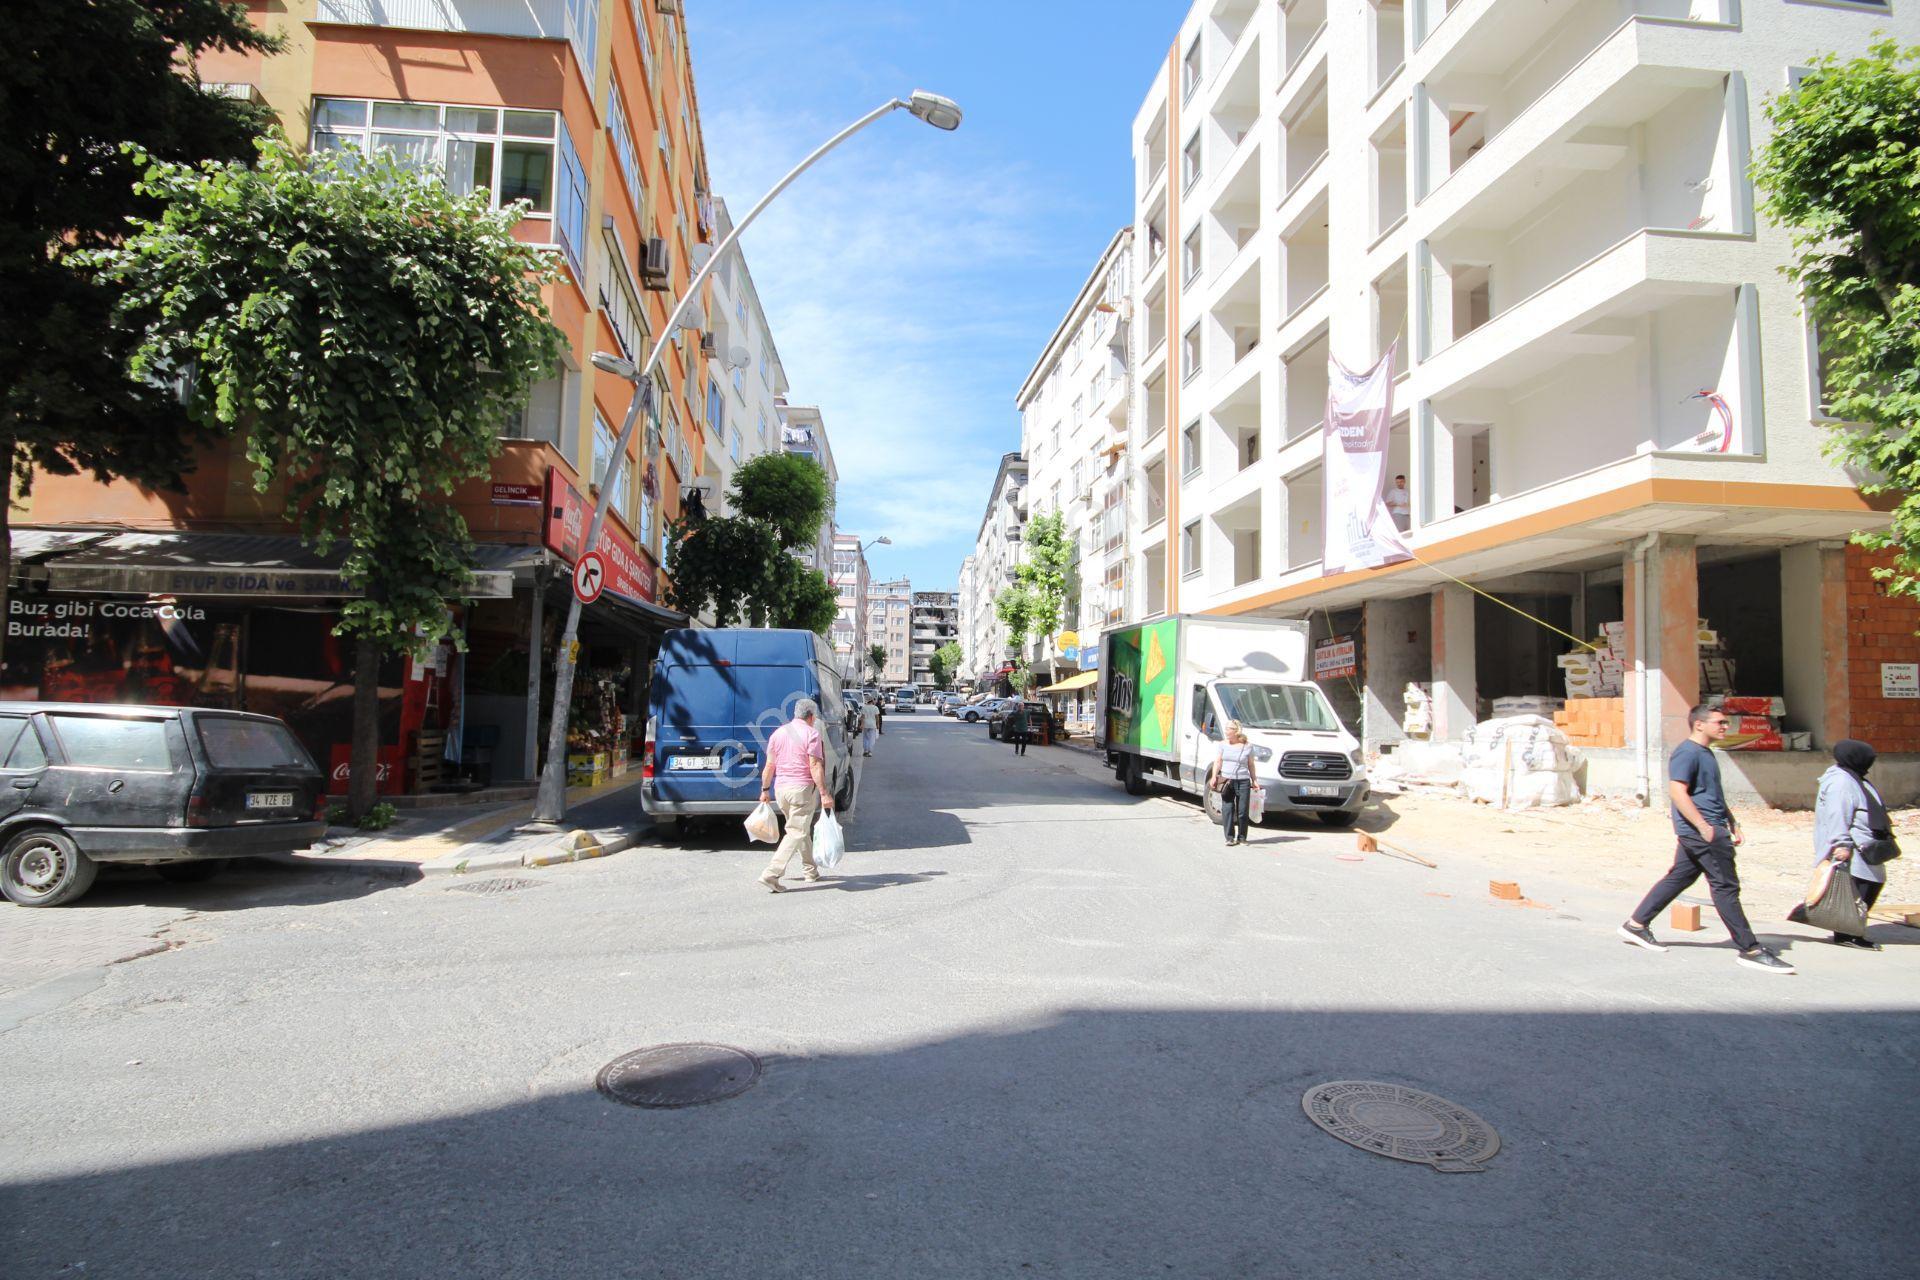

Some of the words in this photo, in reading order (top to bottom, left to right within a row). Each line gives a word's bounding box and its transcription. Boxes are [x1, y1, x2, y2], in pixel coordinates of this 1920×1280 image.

[494, 485, 527, 495] GELİNCİK
[222, 576, 269, 591] GIDA
[276, 579, 296, 591] ve
[9, 600, 48, 616] Buz
[54, 601, 94, 620] gibi
[100, 602, 206, 621] Coca-Cola
[8, 621, 90, 639] Burada!
[250, 793, 260, 806] 34
